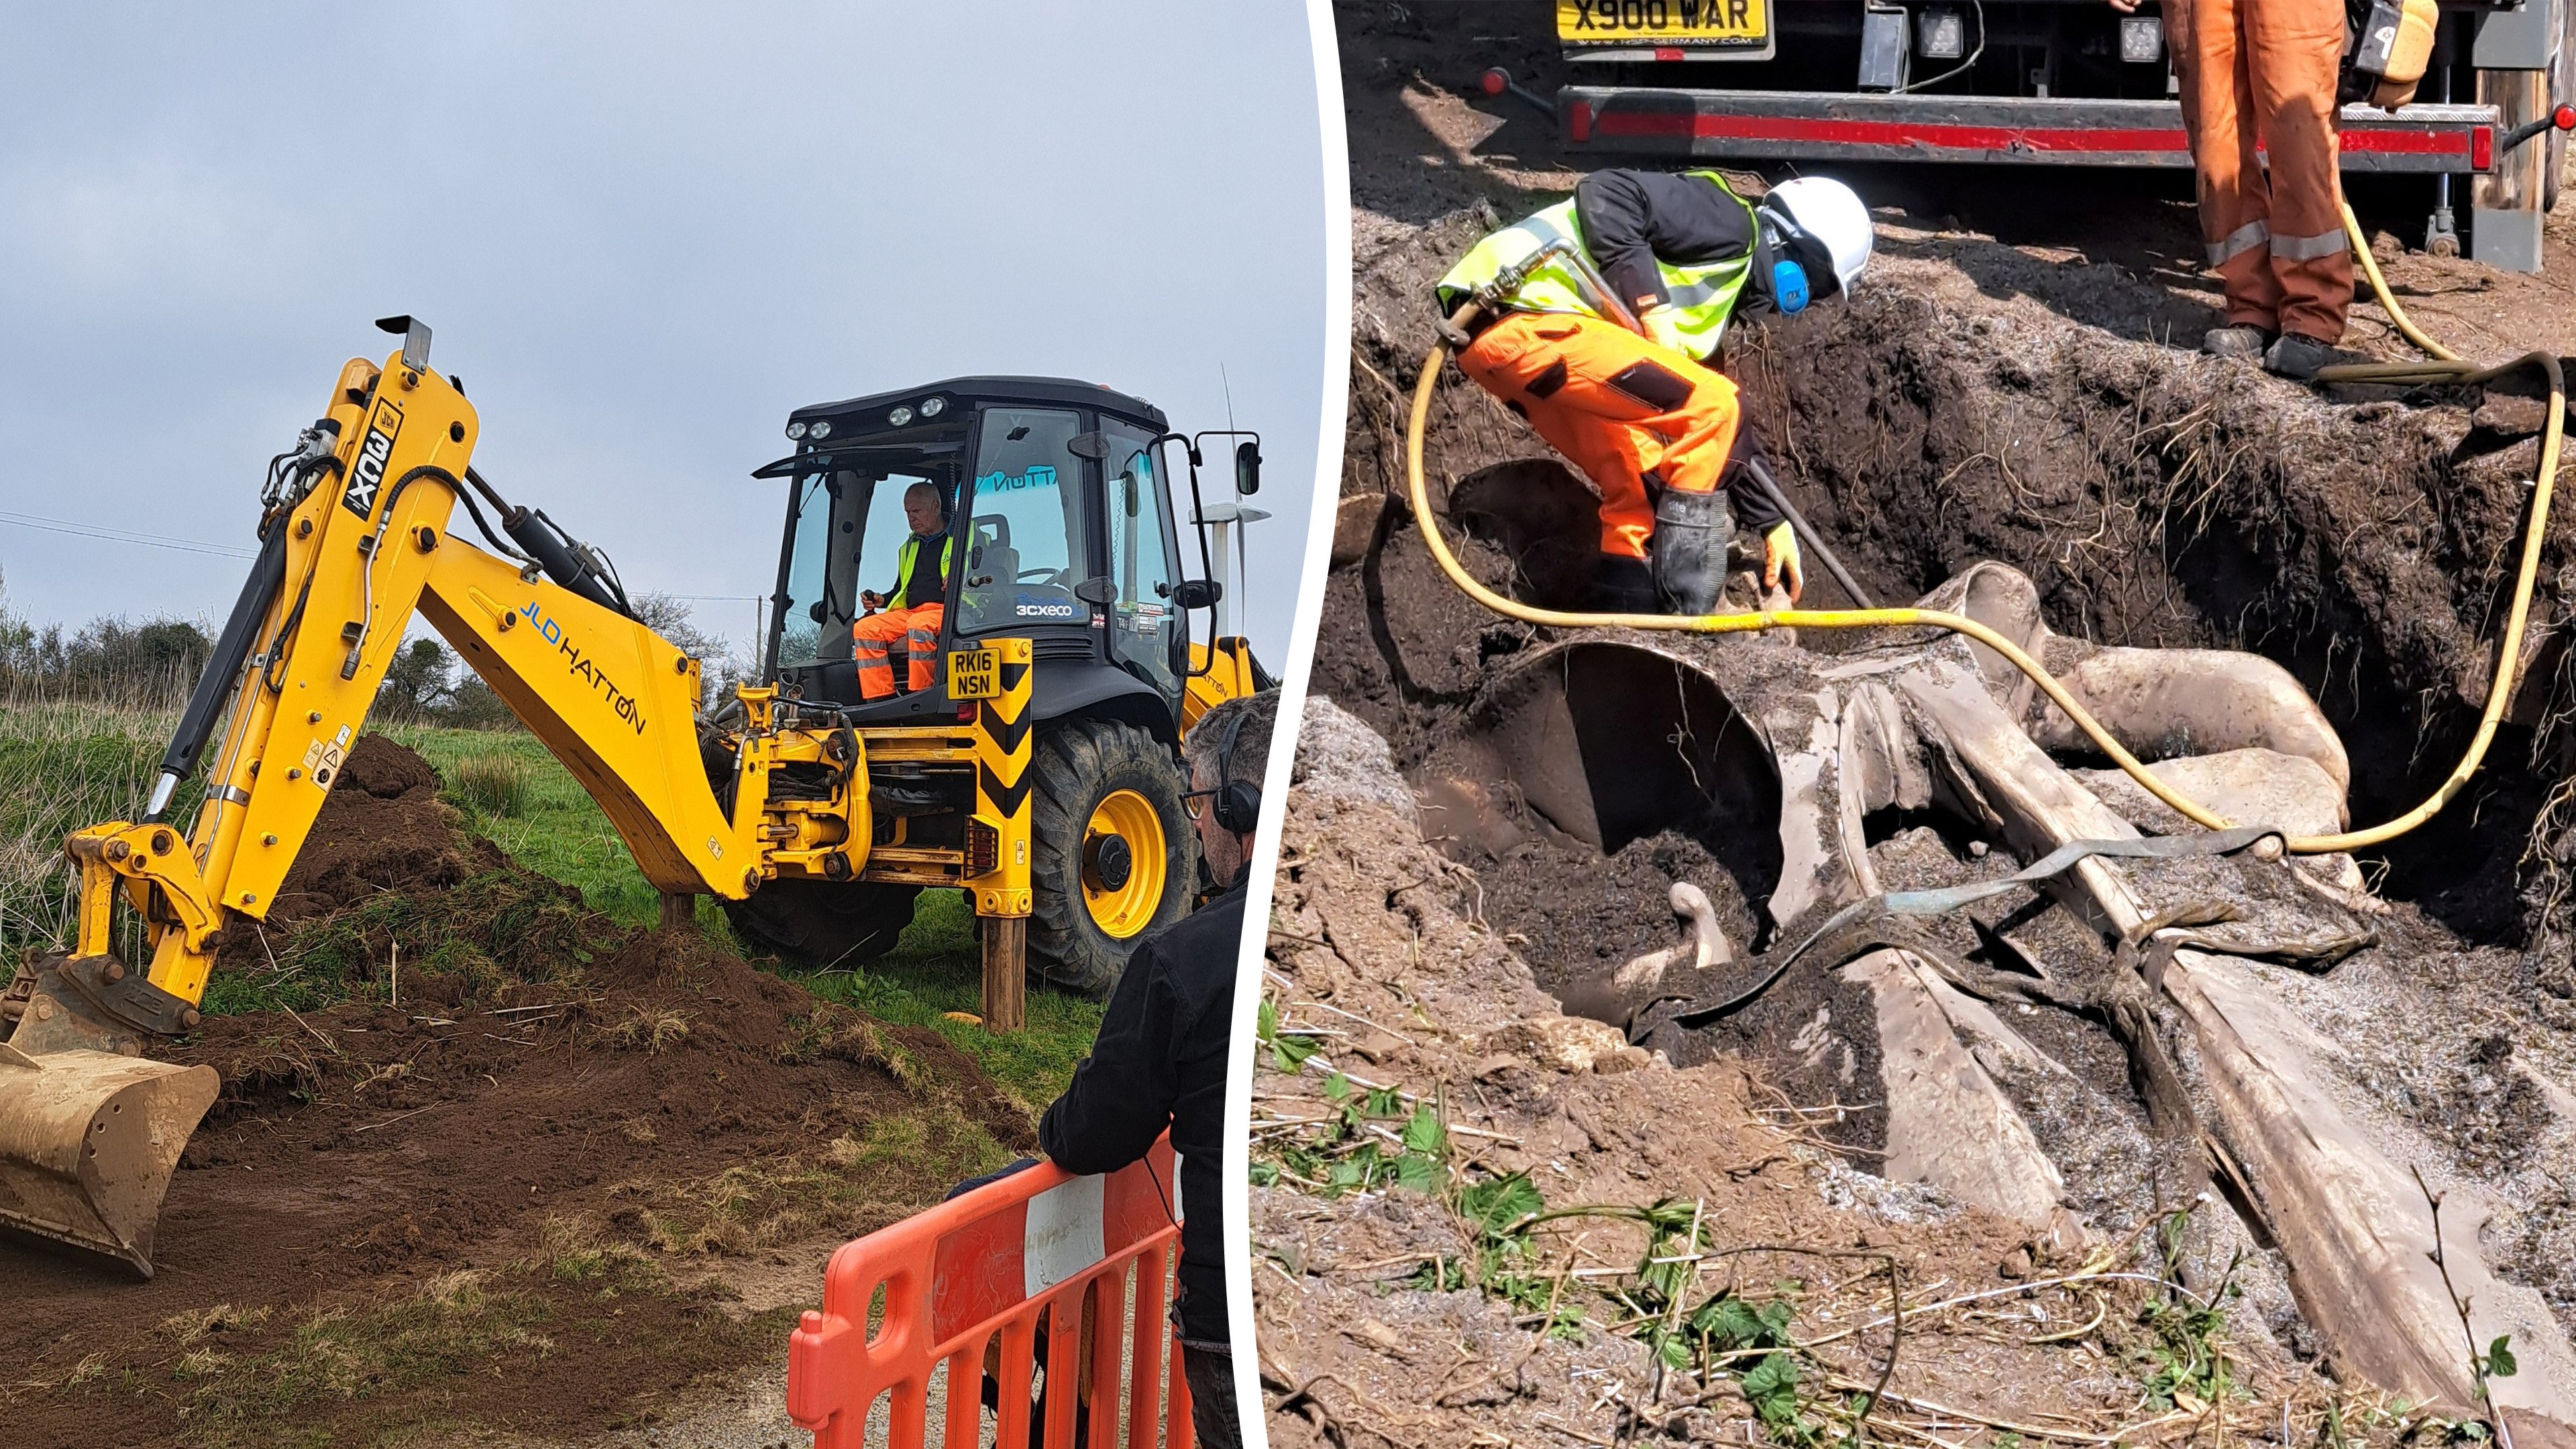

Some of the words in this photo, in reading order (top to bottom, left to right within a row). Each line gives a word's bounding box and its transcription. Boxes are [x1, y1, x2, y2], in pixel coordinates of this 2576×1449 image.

[1574, 0, 1668, 30] X900
[1680, 0, 1749, 29] WAR
[381, 409, 394, 429] JCB
[347, 431, 390, 508] 3CX
[519, 601, 561, 645] JLD
[559, 637, 646, 736] HATTON
[955, 652, 991, 673] RK16
[958, 675, 990, 695] NSN
